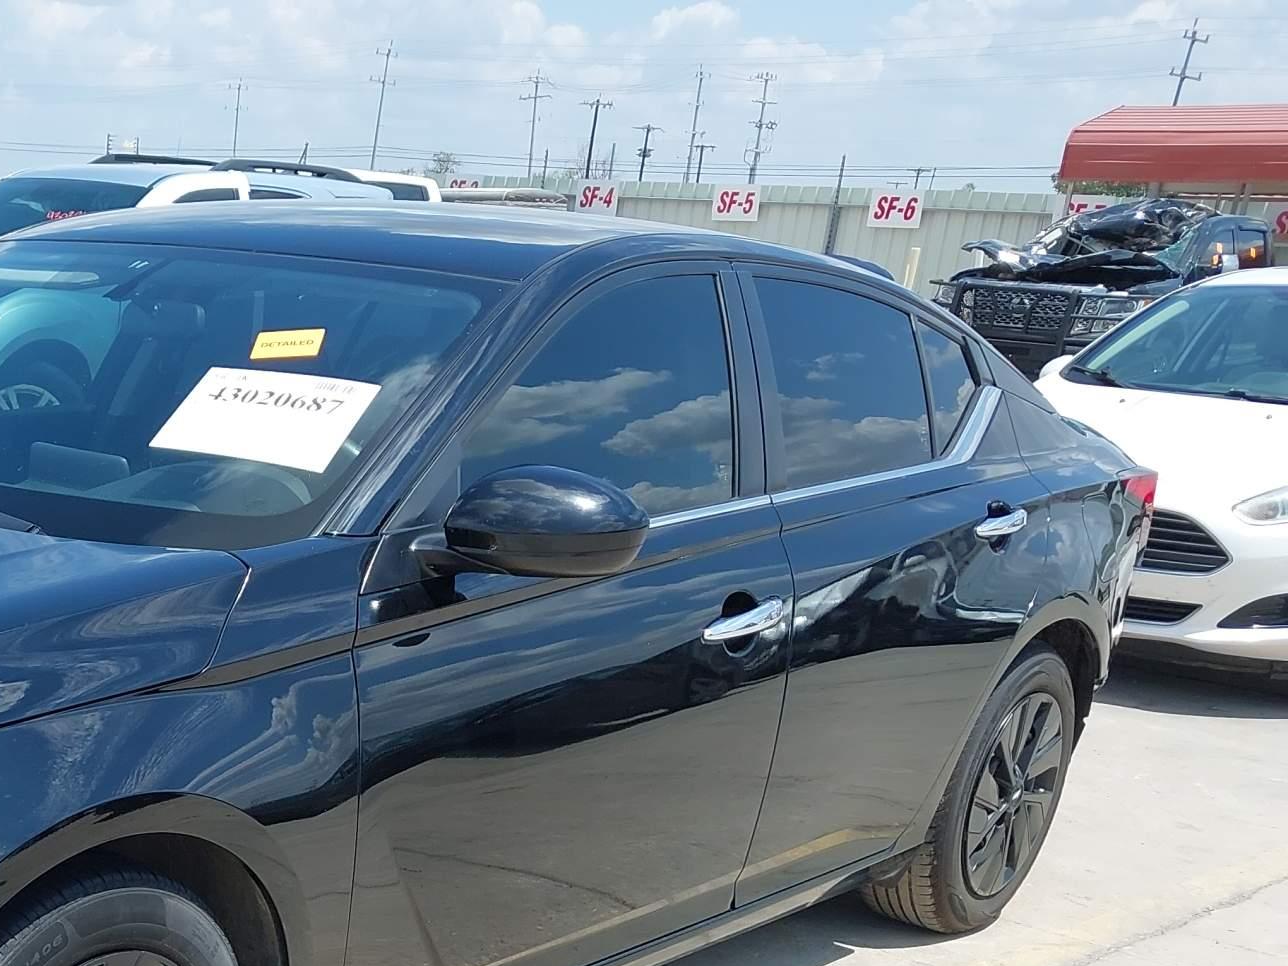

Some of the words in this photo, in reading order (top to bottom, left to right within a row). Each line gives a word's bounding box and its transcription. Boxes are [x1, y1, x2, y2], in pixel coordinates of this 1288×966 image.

[579, 186, 615, 208] SF-4
[717, 190, 755, 214] SF-5
[873, 196, 918, 220] SF-6
[260, 339, 314, 348] DETAILED
[208, 386, 344, 415] 43020687
